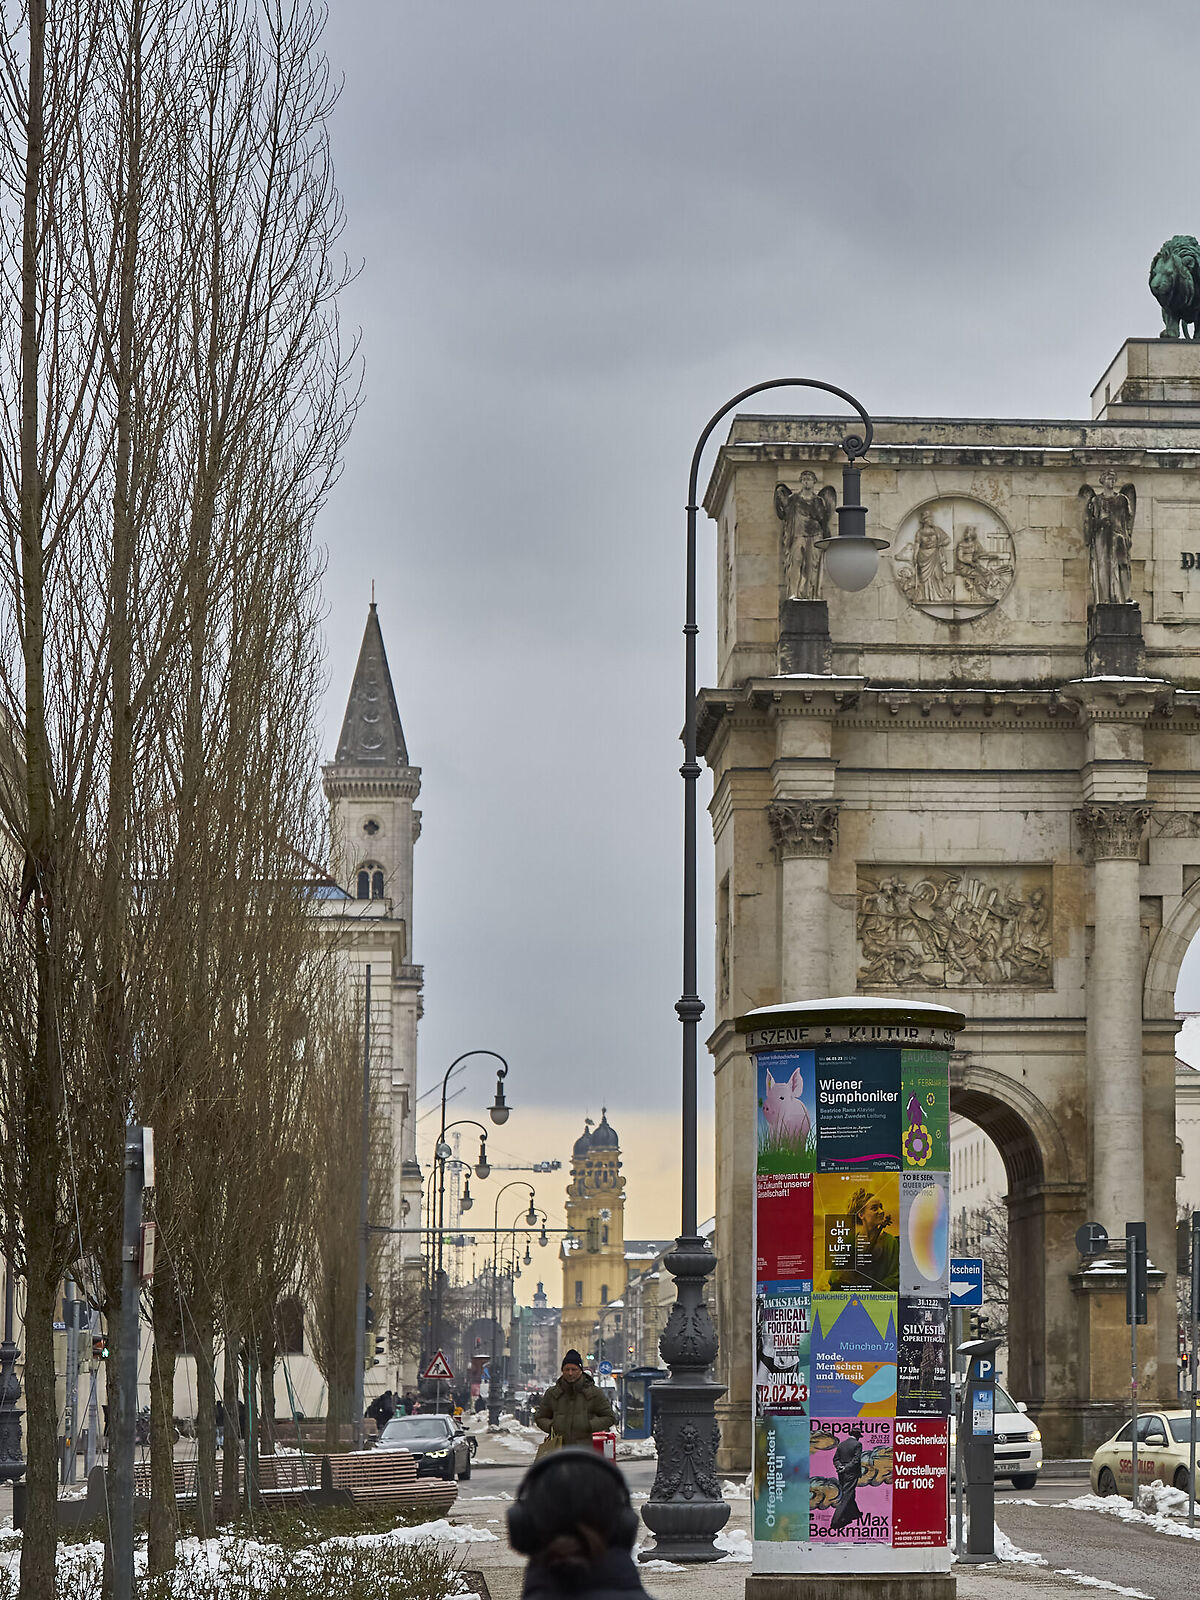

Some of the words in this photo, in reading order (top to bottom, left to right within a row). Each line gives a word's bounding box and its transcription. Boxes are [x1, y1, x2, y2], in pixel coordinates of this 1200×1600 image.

[819, 1078, 863, 1090] Wiener
[819, 1090, 899, 1105] Symphoniker
[783, 1180, 811, 1188] unserer
[836, 1220, 845, 1228] LI
[830, 1228, 851, 1236] CHT
[837, 1236, 844, 1244] &
[829, 1244, 852, 1252] LUFT
[763, 1296, 811, 1309] BACKSTAGE
[762, 1308, 806, 1321] AMERICAN
[767, 1321, 810, 1334] FOOTBALL
[773, 1334, 801, 1347] FINALE
[839, 1341, 882, 1351] München
[884, 1342, 895, 1351] 72
[816, 1352, 845, 1362] Mode,
[816, 1362, 863, 1371] Menschen
[899, 1366, 908, 1374] 17
[908, 1366, 920, 1374] Uhr
[979, 1360, 992, 1378] P
[767, 1371, 805, 1385] SONNTAG
[815, 1372, 834, 1380] und
[835, 1372, 864, 1380] Musik
[759, 1384, 808, 1403] 12.02.23
[809, 1419, 891, 1436] Departure
[895, 1422, 917, 1433] MK:
[895, 1433, 947, 1445] Geschenkabo
[895, 1451, 917, 1463] Vier
[1119, 1458, 1155, 1475] SEGÜLLER
[764, 1429, 776, 1528] Öffentlichkeit
[894, 1478, 910, 1490] für
[911, 1477, 935, 1489] 100€
[775, 1472, 786, 1502] aller
[856, 1512, 889, 1527] Max
[809, 1523, 889, 1538] Beckmann
